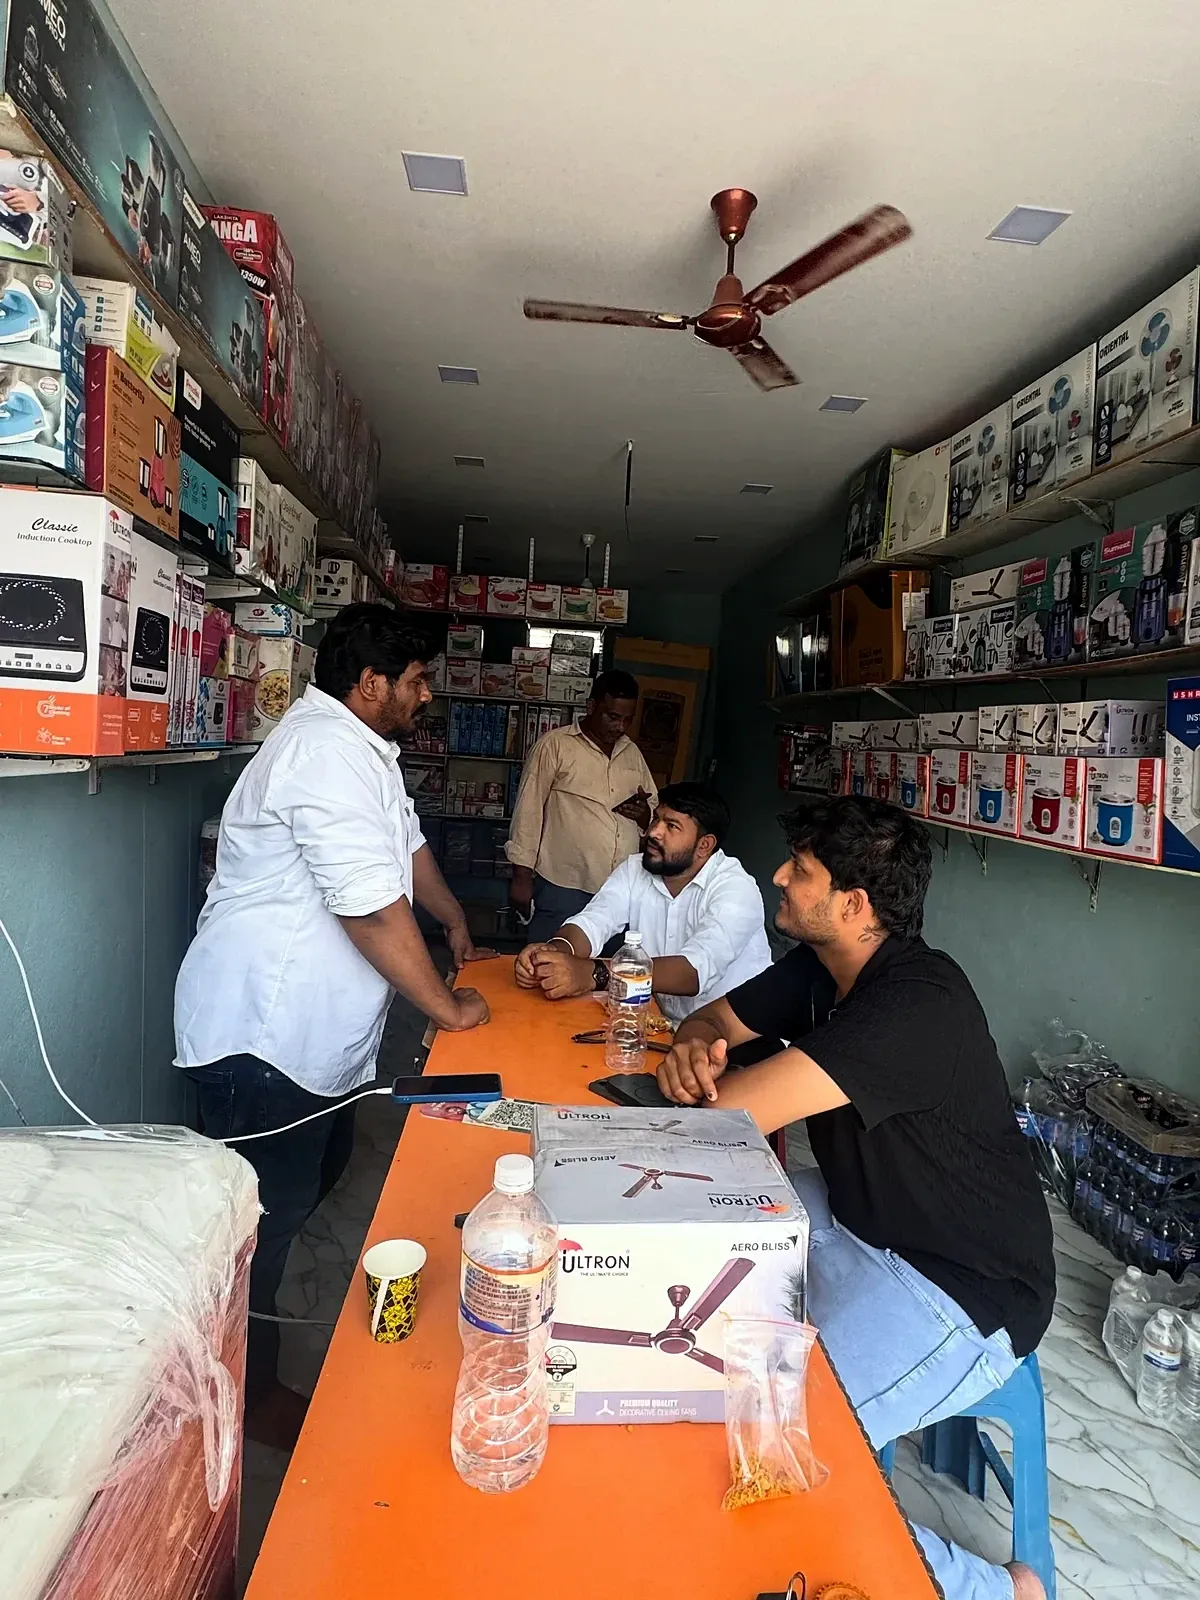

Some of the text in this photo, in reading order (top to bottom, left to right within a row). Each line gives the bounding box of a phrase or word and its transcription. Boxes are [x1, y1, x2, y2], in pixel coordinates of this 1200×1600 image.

[39, 0, 66, 39] MEO
[206, 216, 258, 243] ANGA
[240, 268, 267, 288] 1350W
[1100, 330, 1129, 360] ORIENTAL
[31, 517, 79, 533] Classic
[17, 532, 92, 547] Induction Cooktop
[1103, 540, 1131, 556] Sumeet
[1173, 689, 1200, 699] USHA
[557, 1110, 612, 1121] ULTRON
[708, 1194, 773, 1207] ULTRON
[731, 1241, 790, 1252] AERO BLISS
[562, 1249, 630, 1273] ULTRON
[619, 1399, 679, 1408] PREMIUM QUALITY
[619, 1407, 697, 1417] DECORATIVE CEILING FANS
